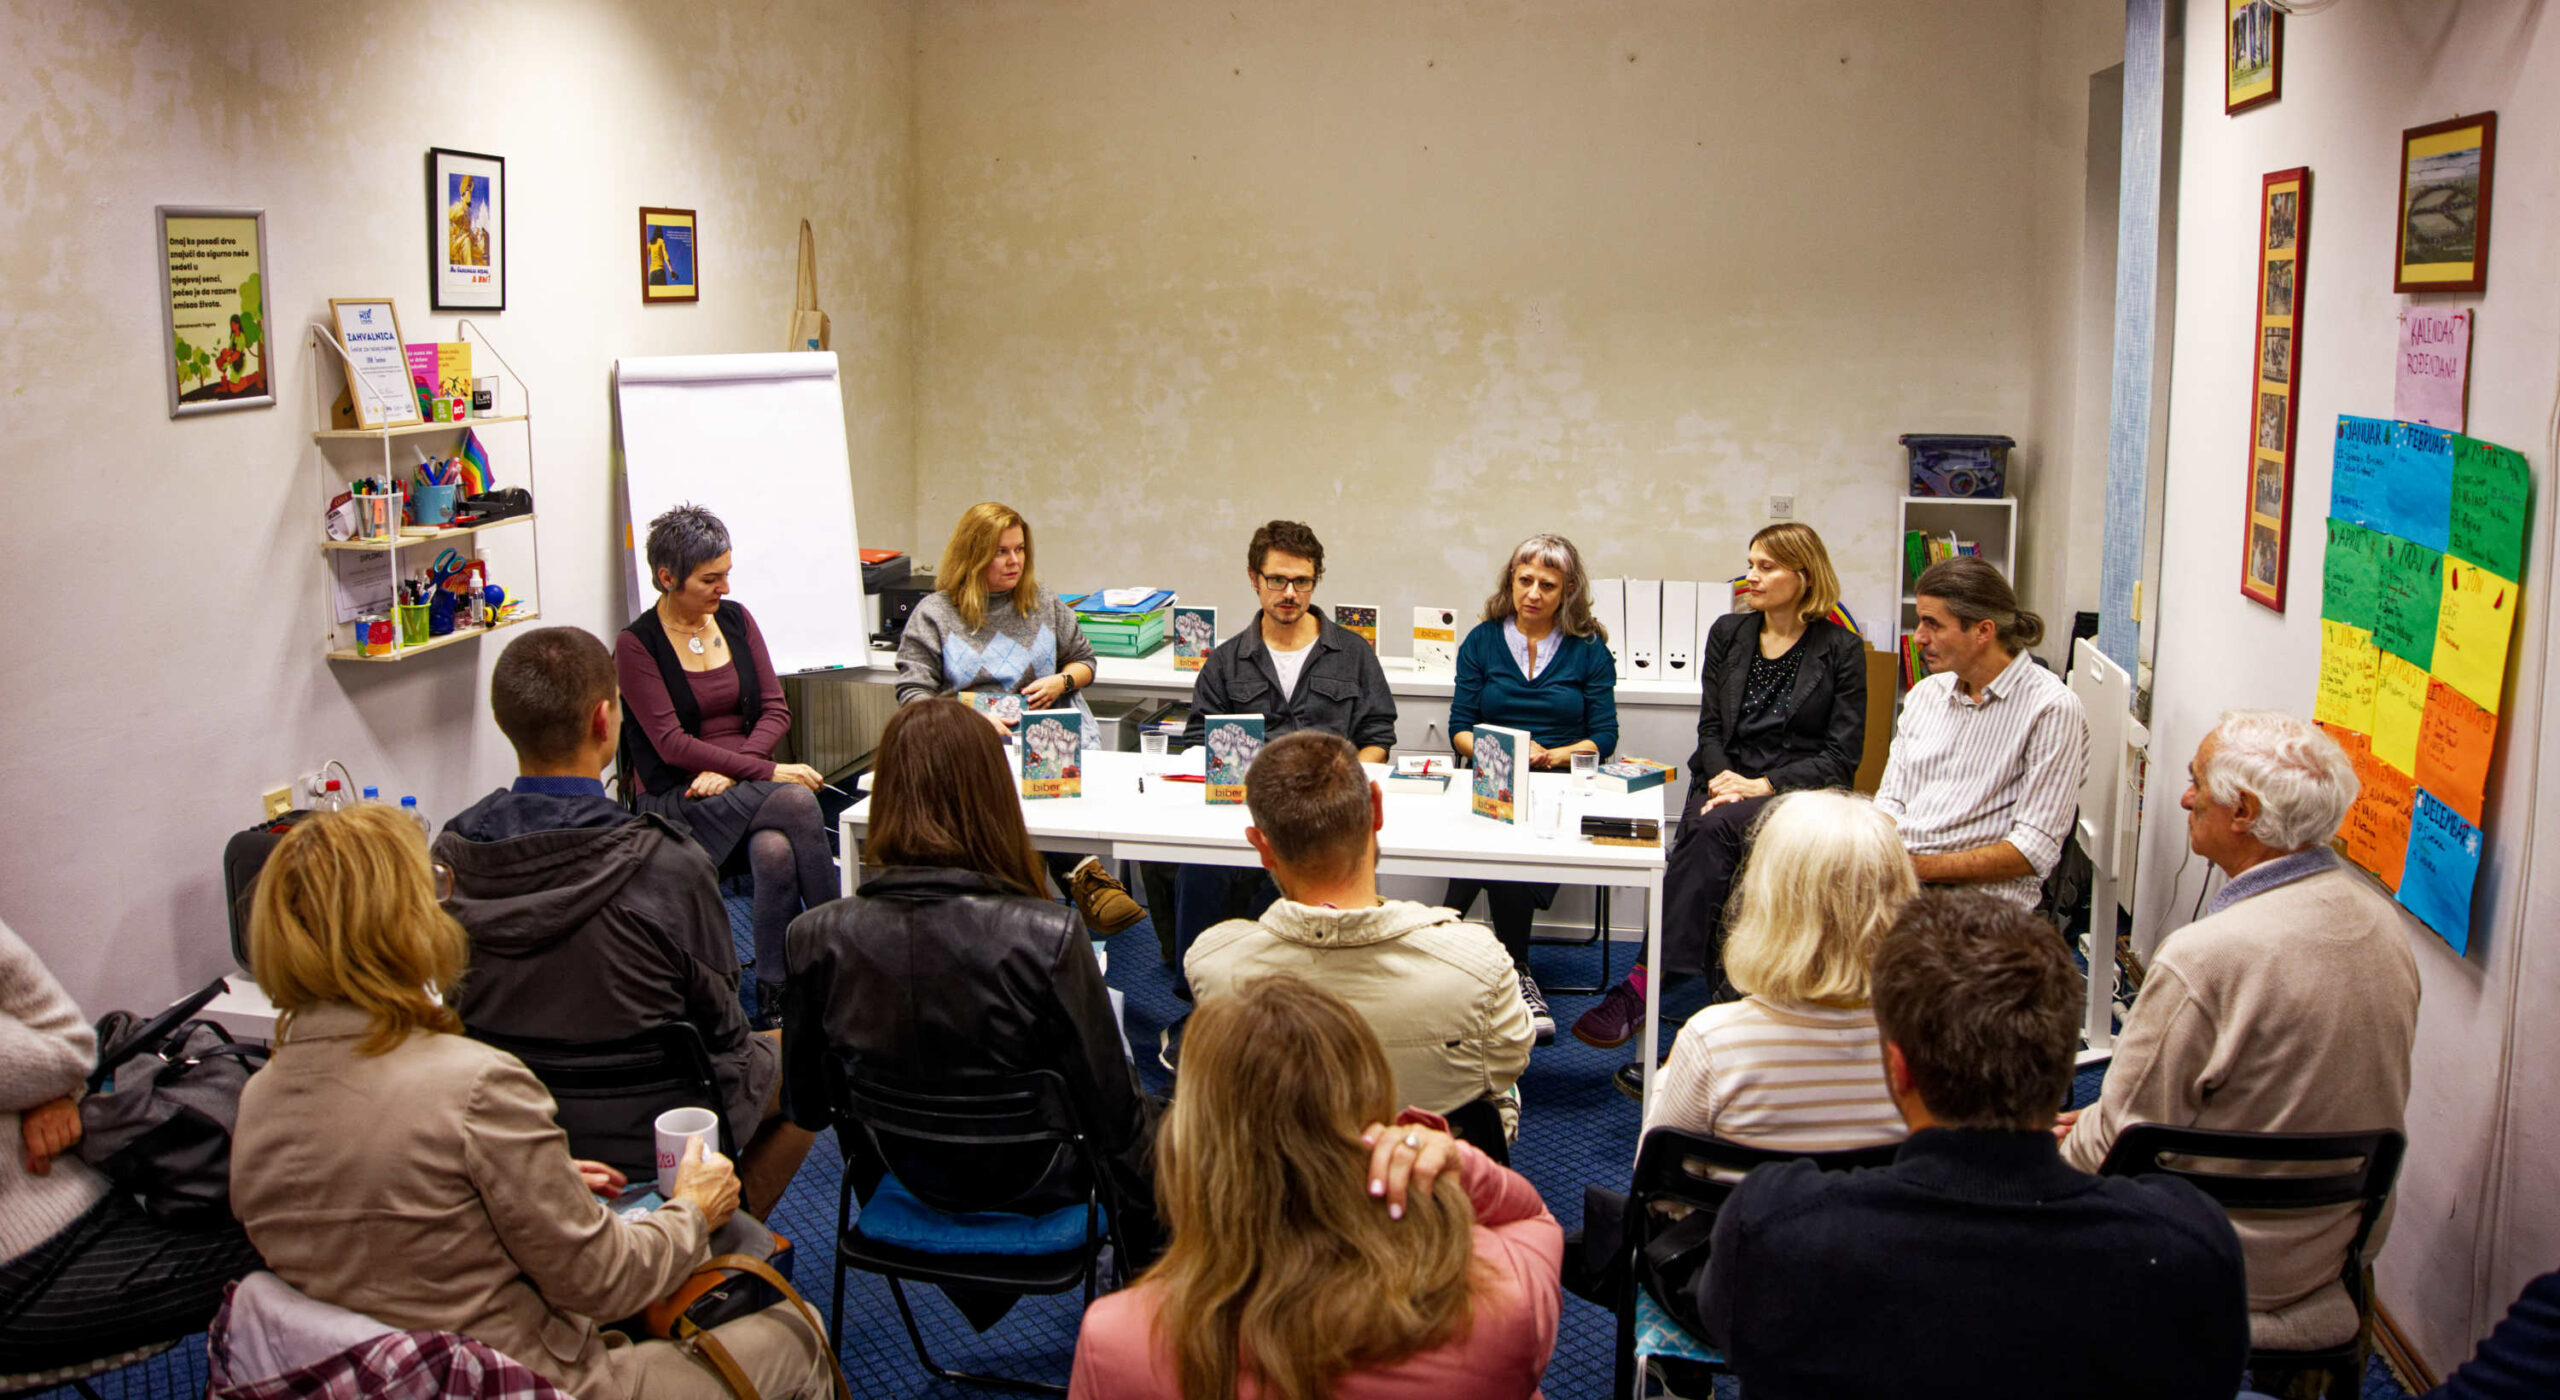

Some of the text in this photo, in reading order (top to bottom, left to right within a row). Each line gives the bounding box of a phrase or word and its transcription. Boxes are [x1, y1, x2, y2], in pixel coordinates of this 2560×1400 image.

[169, 237, 186, 247] Onaj
[196, 237, 220, 247] posadi
[196, 250, 206, 258] da
[206, 249, 232, 260] sigurno
[171, 262, 193, 271] sedeti
[171, 274, 222, 286] njegovoj senci,
[194, 288, 200, 298] je
[173, 301, 198, 310] smisao
[346, 331, 395, 342] ZAHVALNICA
[2410, 317, 2456, 346] KALENDAR
[2345, 420, 2382, 446] JANUAR
[2406, 426, 2447, 456] FEBRUAR
[1033, 783, 1060, 792] biber
[1215, 788, 1242, 797] biber
[1477, 800, 1498, 813] biber
[2423, 793, 2470, 848] DECEMBAR
